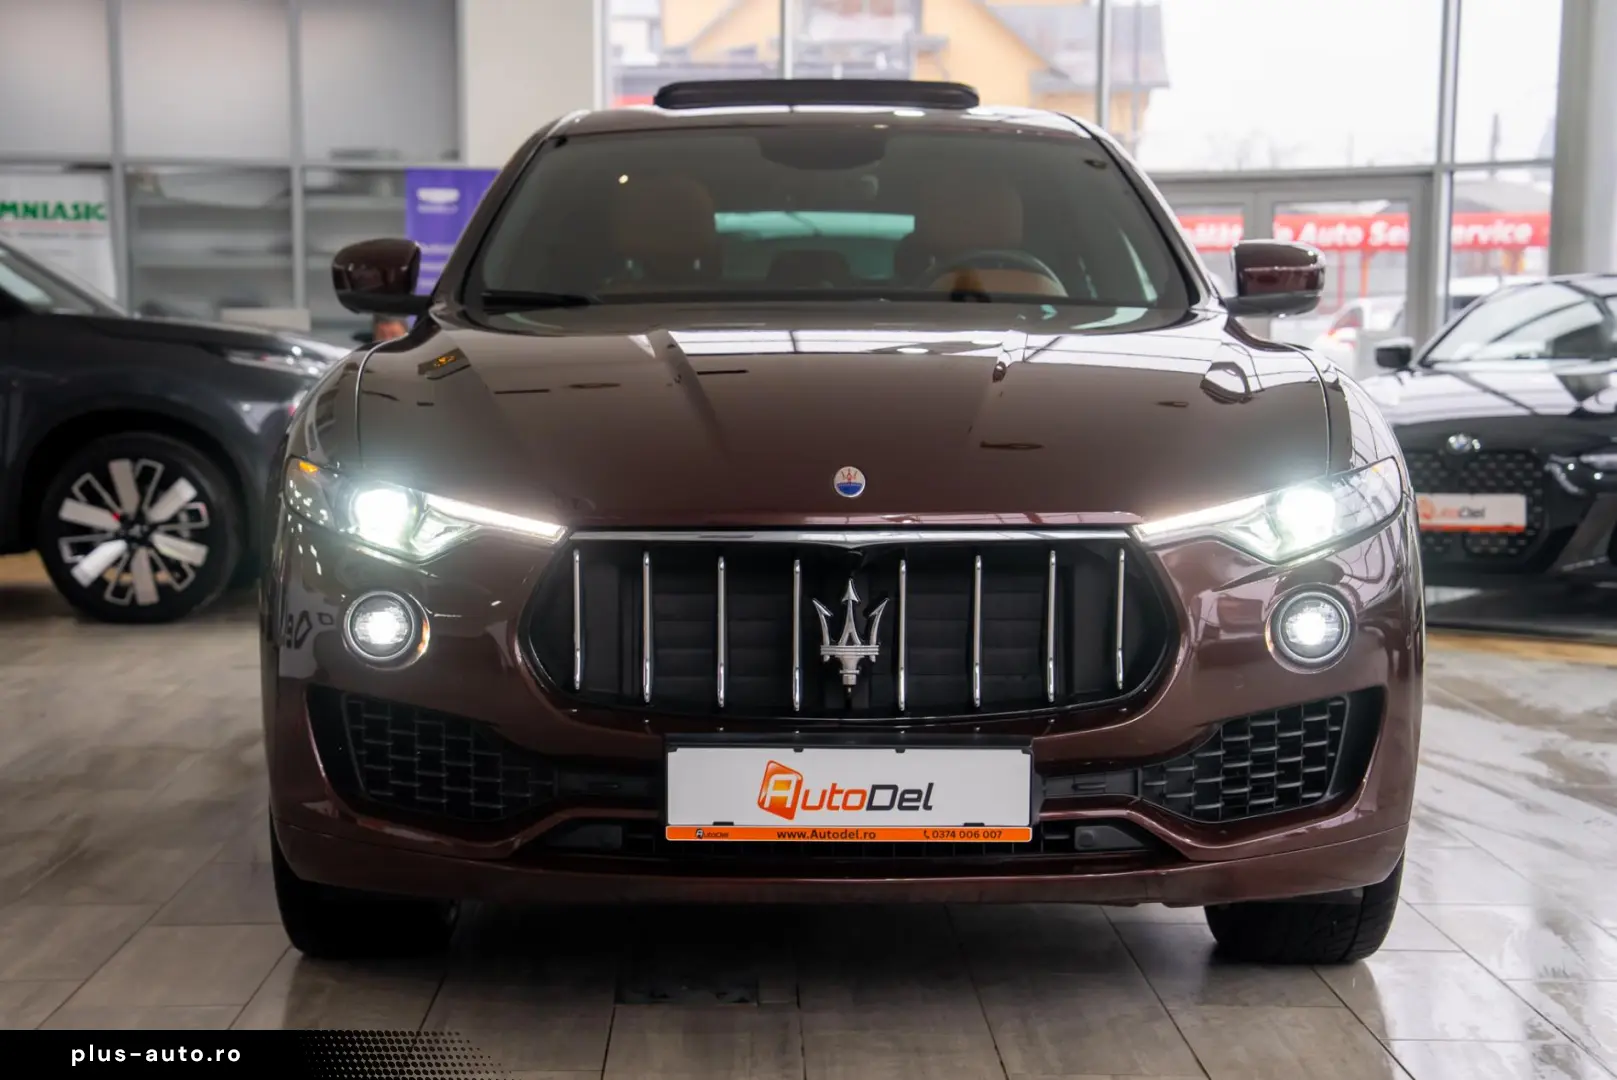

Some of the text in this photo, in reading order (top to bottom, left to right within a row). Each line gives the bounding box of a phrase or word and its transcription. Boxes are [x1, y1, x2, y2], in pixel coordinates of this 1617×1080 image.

[0, 201, 107, 220] MNIASIG
[1298, 222, 1364, 247] Auto
[761, 768, 934, 813] AutoDel
[777, 829, 876, 840] www.Autodel.ro
[932, 830, 1003, 839] 0374 006 007
